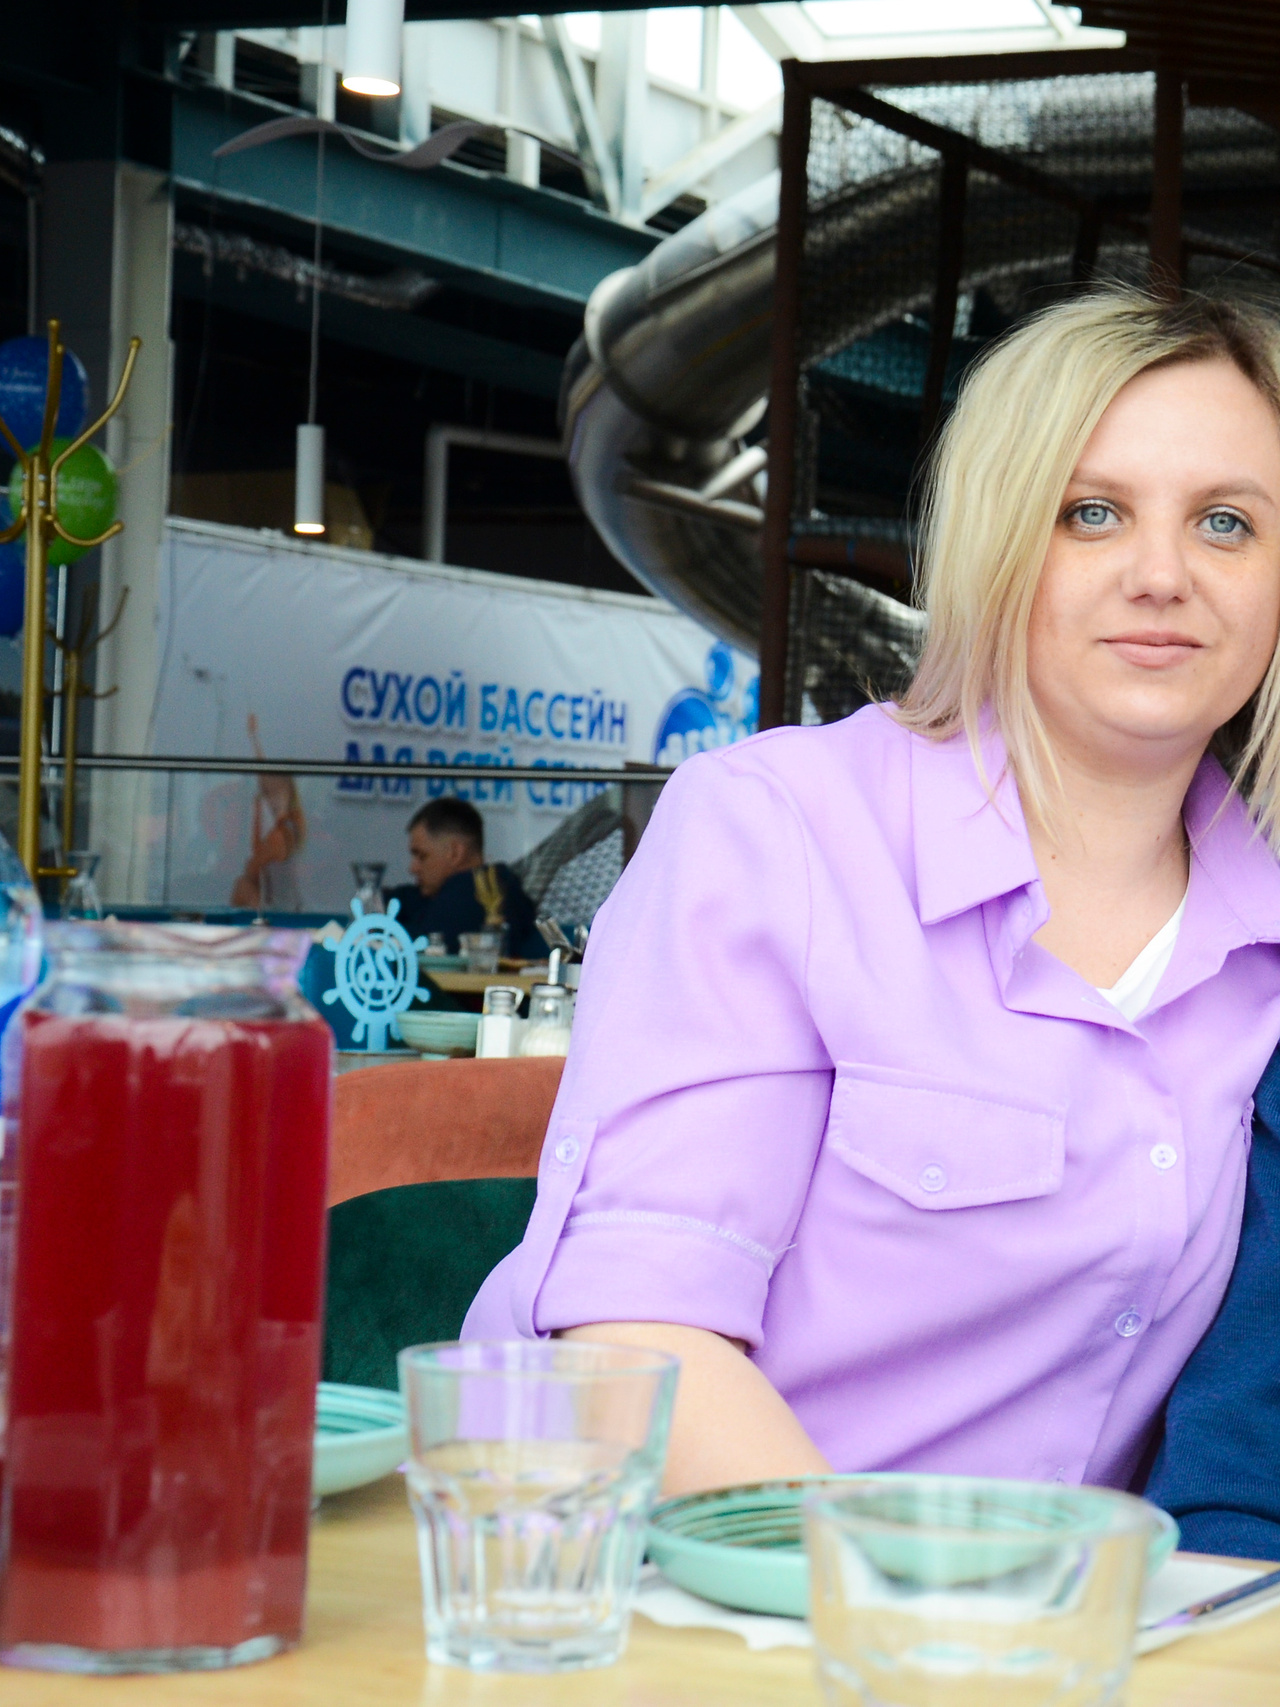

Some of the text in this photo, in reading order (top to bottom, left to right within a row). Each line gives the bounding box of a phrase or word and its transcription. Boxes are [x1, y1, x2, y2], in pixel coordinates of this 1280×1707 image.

[341, 665, 627, 744] СУХОЙ БАССЕЙН
[337, 741, 413, 794] ДЛЯ
[427, 746, 515, 800] ВСЕЙ
